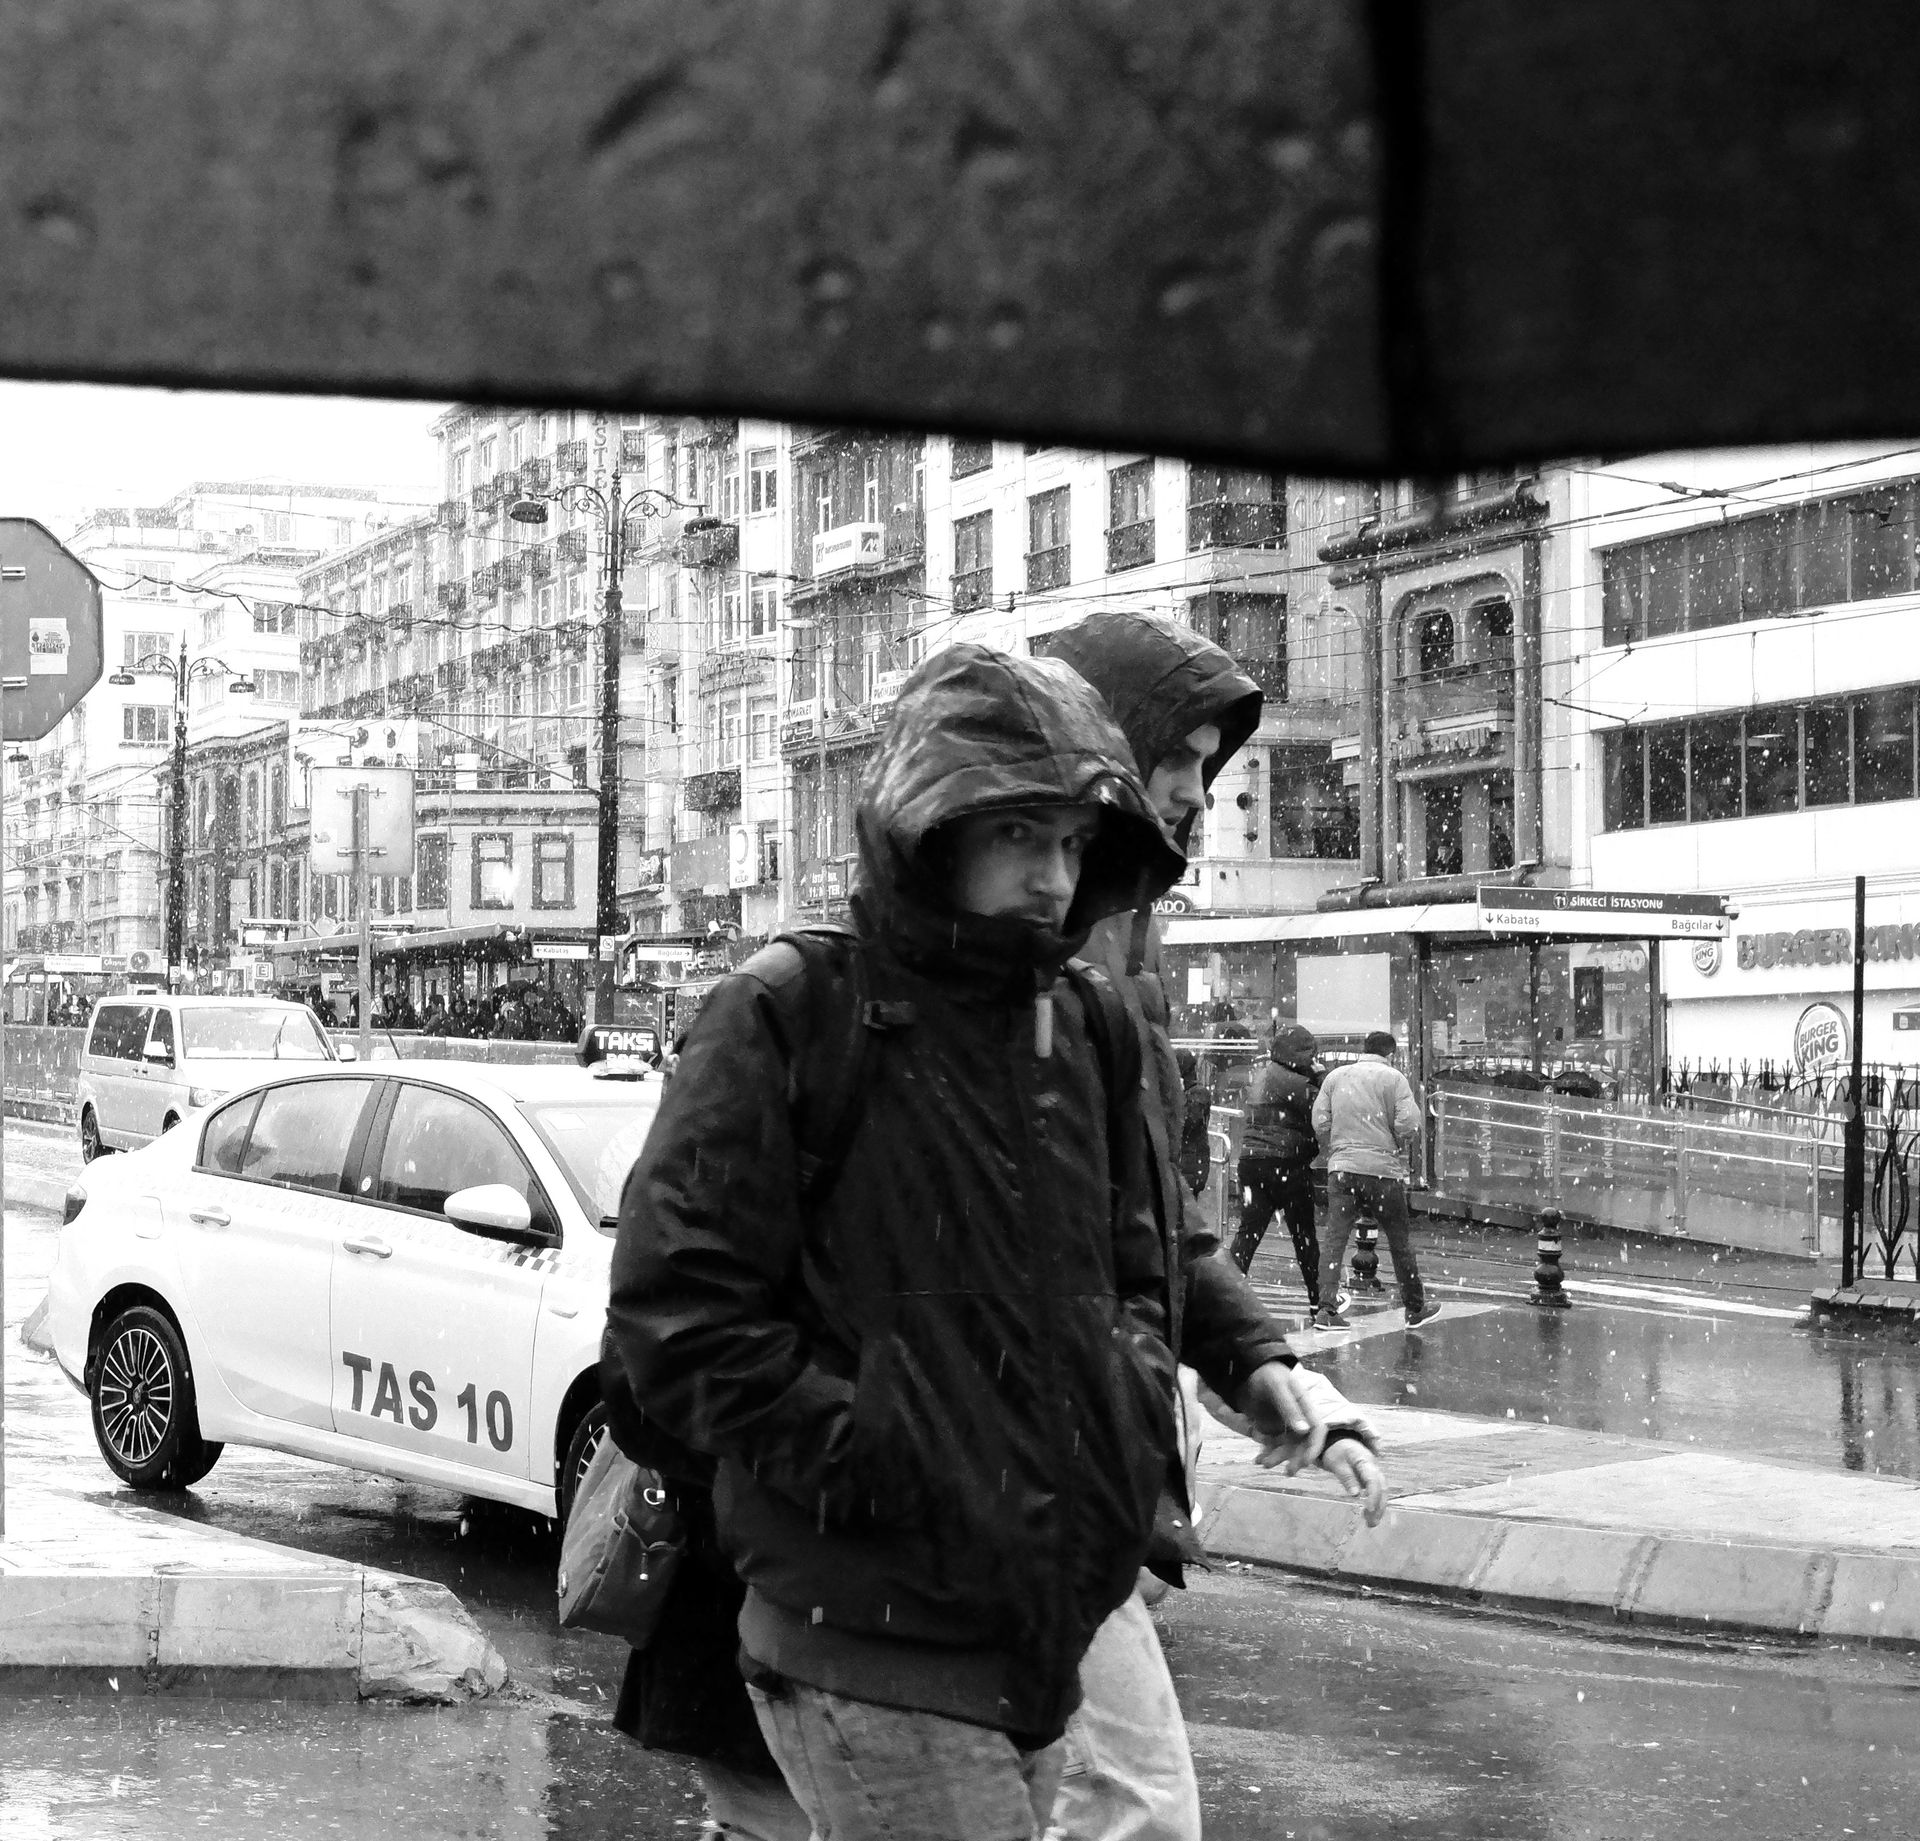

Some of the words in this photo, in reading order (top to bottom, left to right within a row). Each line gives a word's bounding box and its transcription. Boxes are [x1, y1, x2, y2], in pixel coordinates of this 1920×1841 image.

[1151, 900, 1186, 914] ADO
[1555, 896, 1567, 905] T1
[1571, 896, 1607, 907] SİRKECİ
[1610, 897, 1663, 909] İSTASYONU
[1496, 914, 1540, 927] Kabataş
[1671, 919, 1713, 933] Bağcılar
[1736, 928, 1853, 970] BURGER
[1863, 923, 1920, 961] KIN
[1800, 1020, 1838, 1048] BURGER
[1801, 1034, 1839, 1063] KING
[342, 1351, 438, 1431] TAS
[457, 1382, 513, 1452] 10
